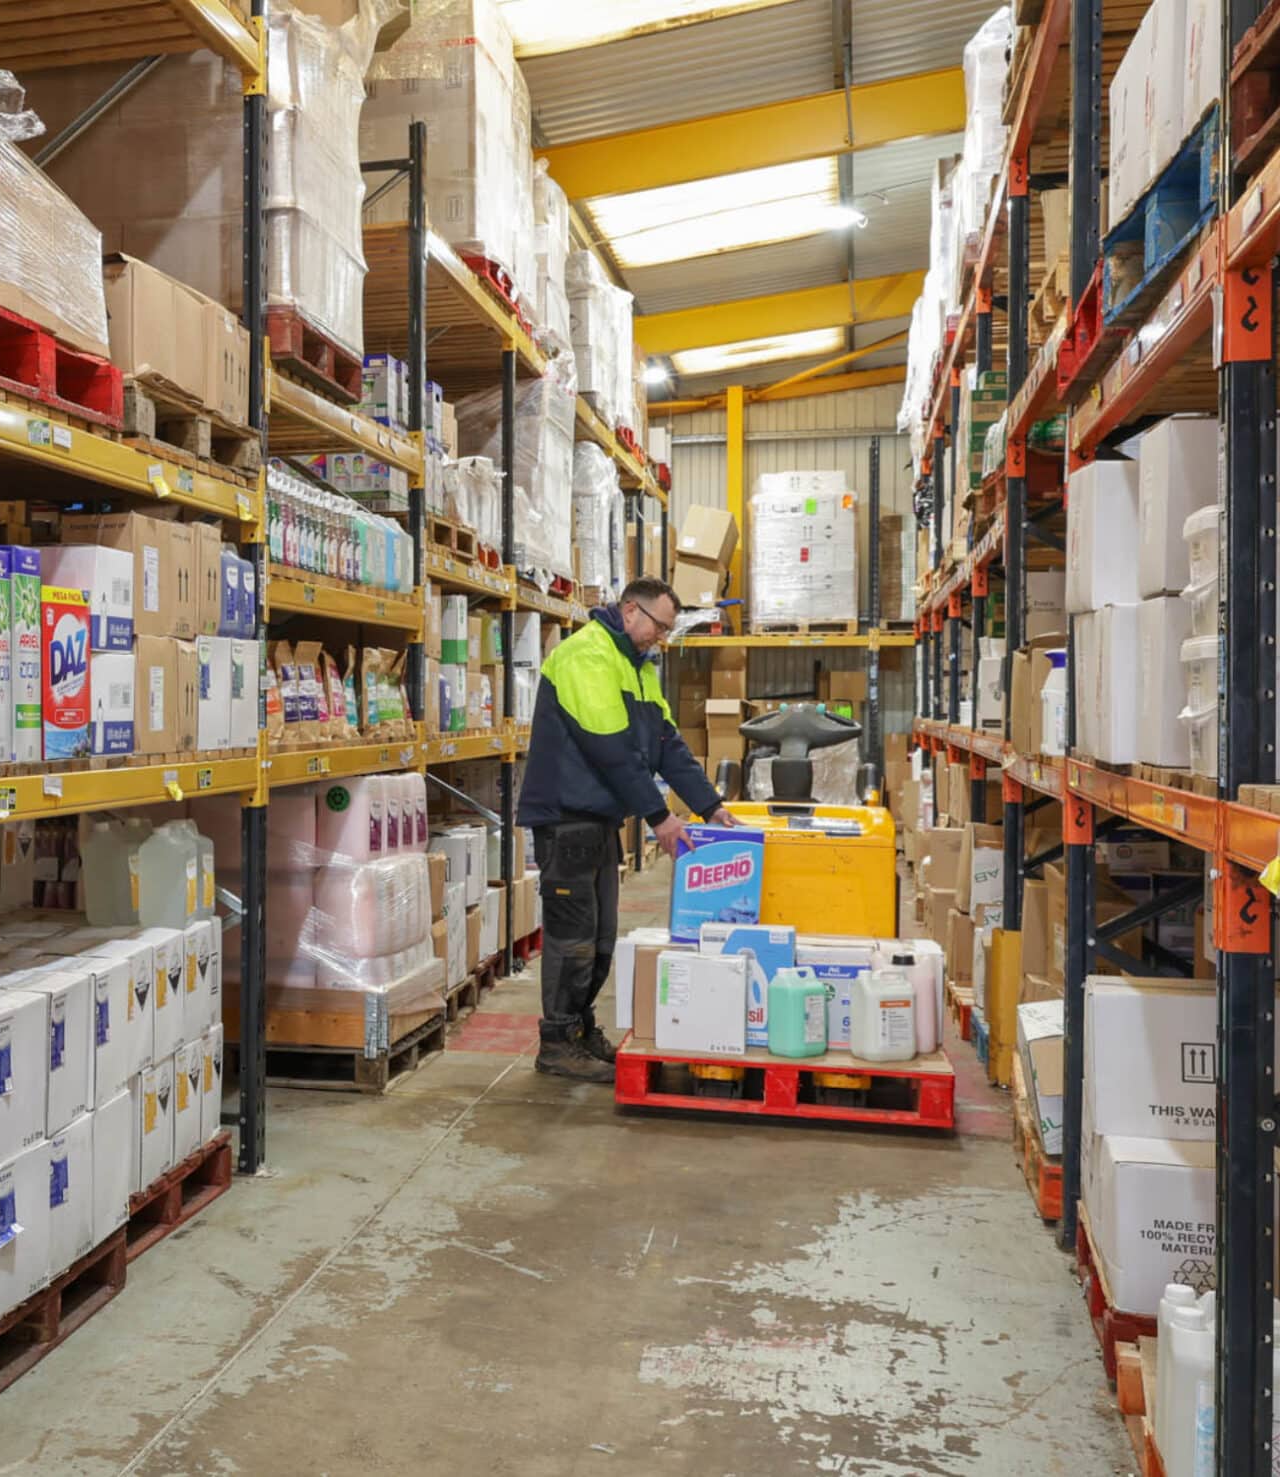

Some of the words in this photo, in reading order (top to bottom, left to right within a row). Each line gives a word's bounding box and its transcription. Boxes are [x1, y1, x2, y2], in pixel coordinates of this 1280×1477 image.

[49, 627, 87, 687] DAZ
[687, 859, 752, 890] DEEPIO
[748, 1007, 764, 1024] sil
[1148, 1104, 1185, 1118] THIS
[1190, 1106, 1217, 1119] WA
[1153, 1219, 1187, 1231] MADE
[1192, 1220, 1217, 1233] FR
[1139, 1229, 1173, 1242] 100%
[1176, 1231, 1217, 1245] RECY
[1161, 1243, 1217, 1256] MATERI
